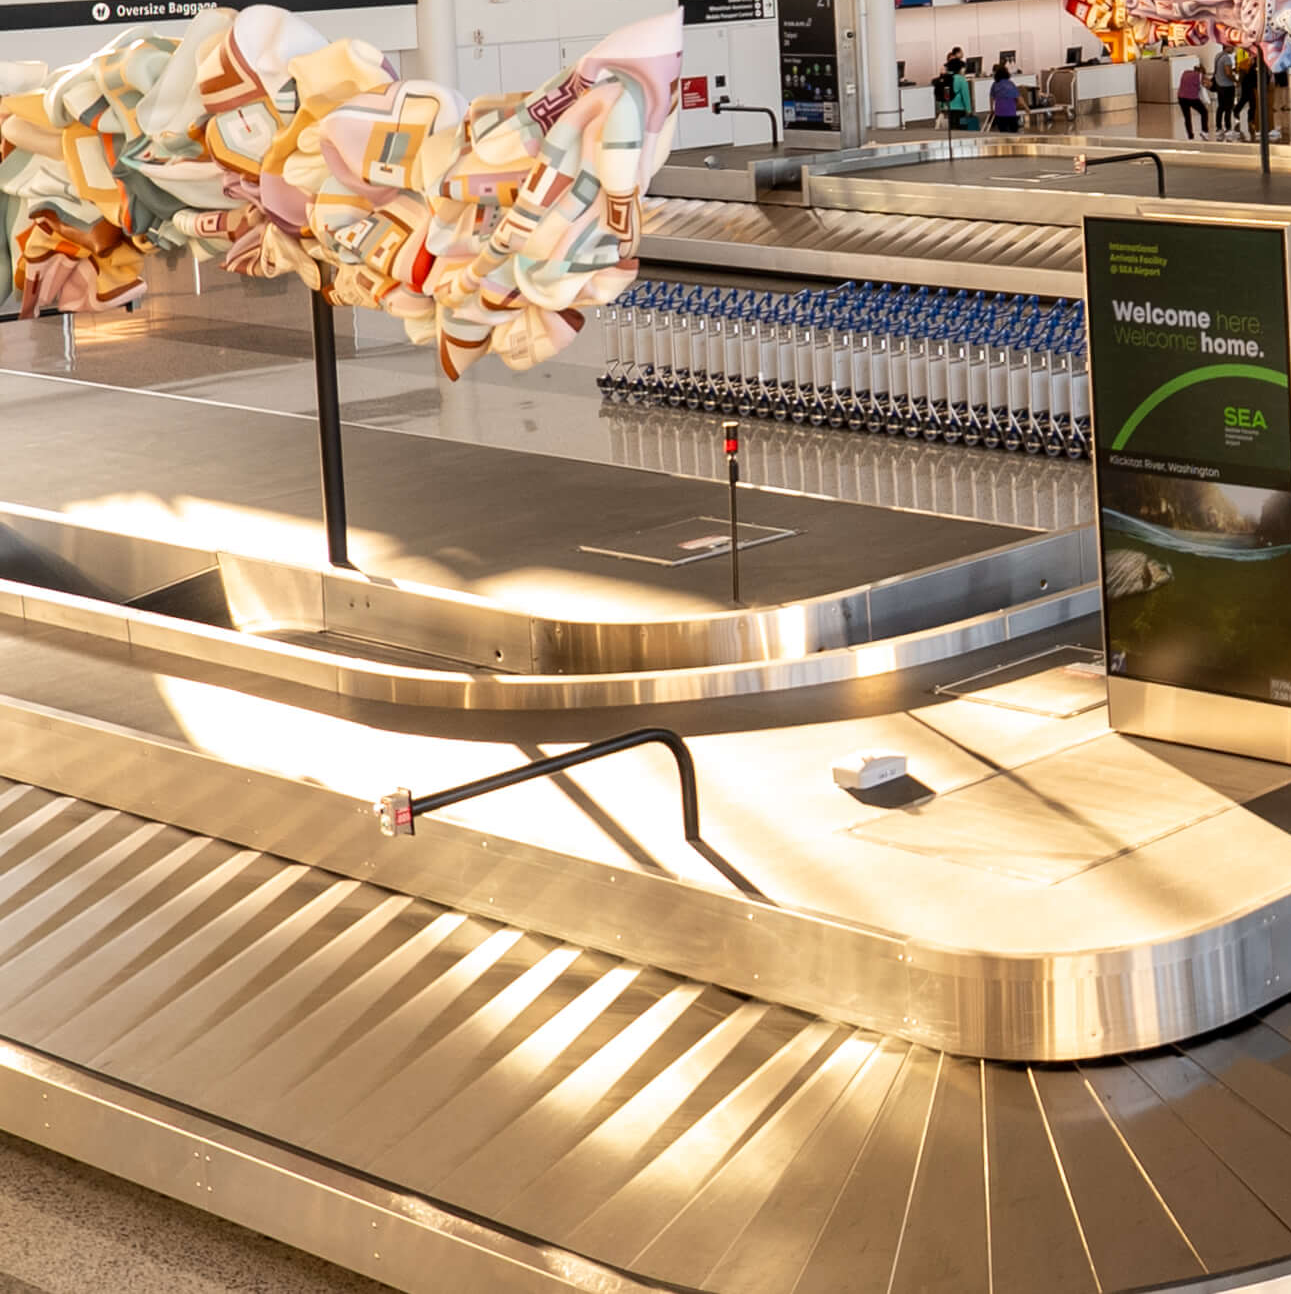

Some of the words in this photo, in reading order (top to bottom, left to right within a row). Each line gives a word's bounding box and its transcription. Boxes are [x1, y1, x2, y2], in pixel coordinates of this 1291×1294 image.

[116, 3, 165, 17] Oversize
[1112, 299, 1211, 329] Welcome
[1216, 310, 1264, 335] here.
[1114, 325, 1197, 351] Welcome
[1200, 330, 1265, 358] home.
[1223, 406, 1268, 430] SEA
[1168, 462, 1220, 479] Washington
